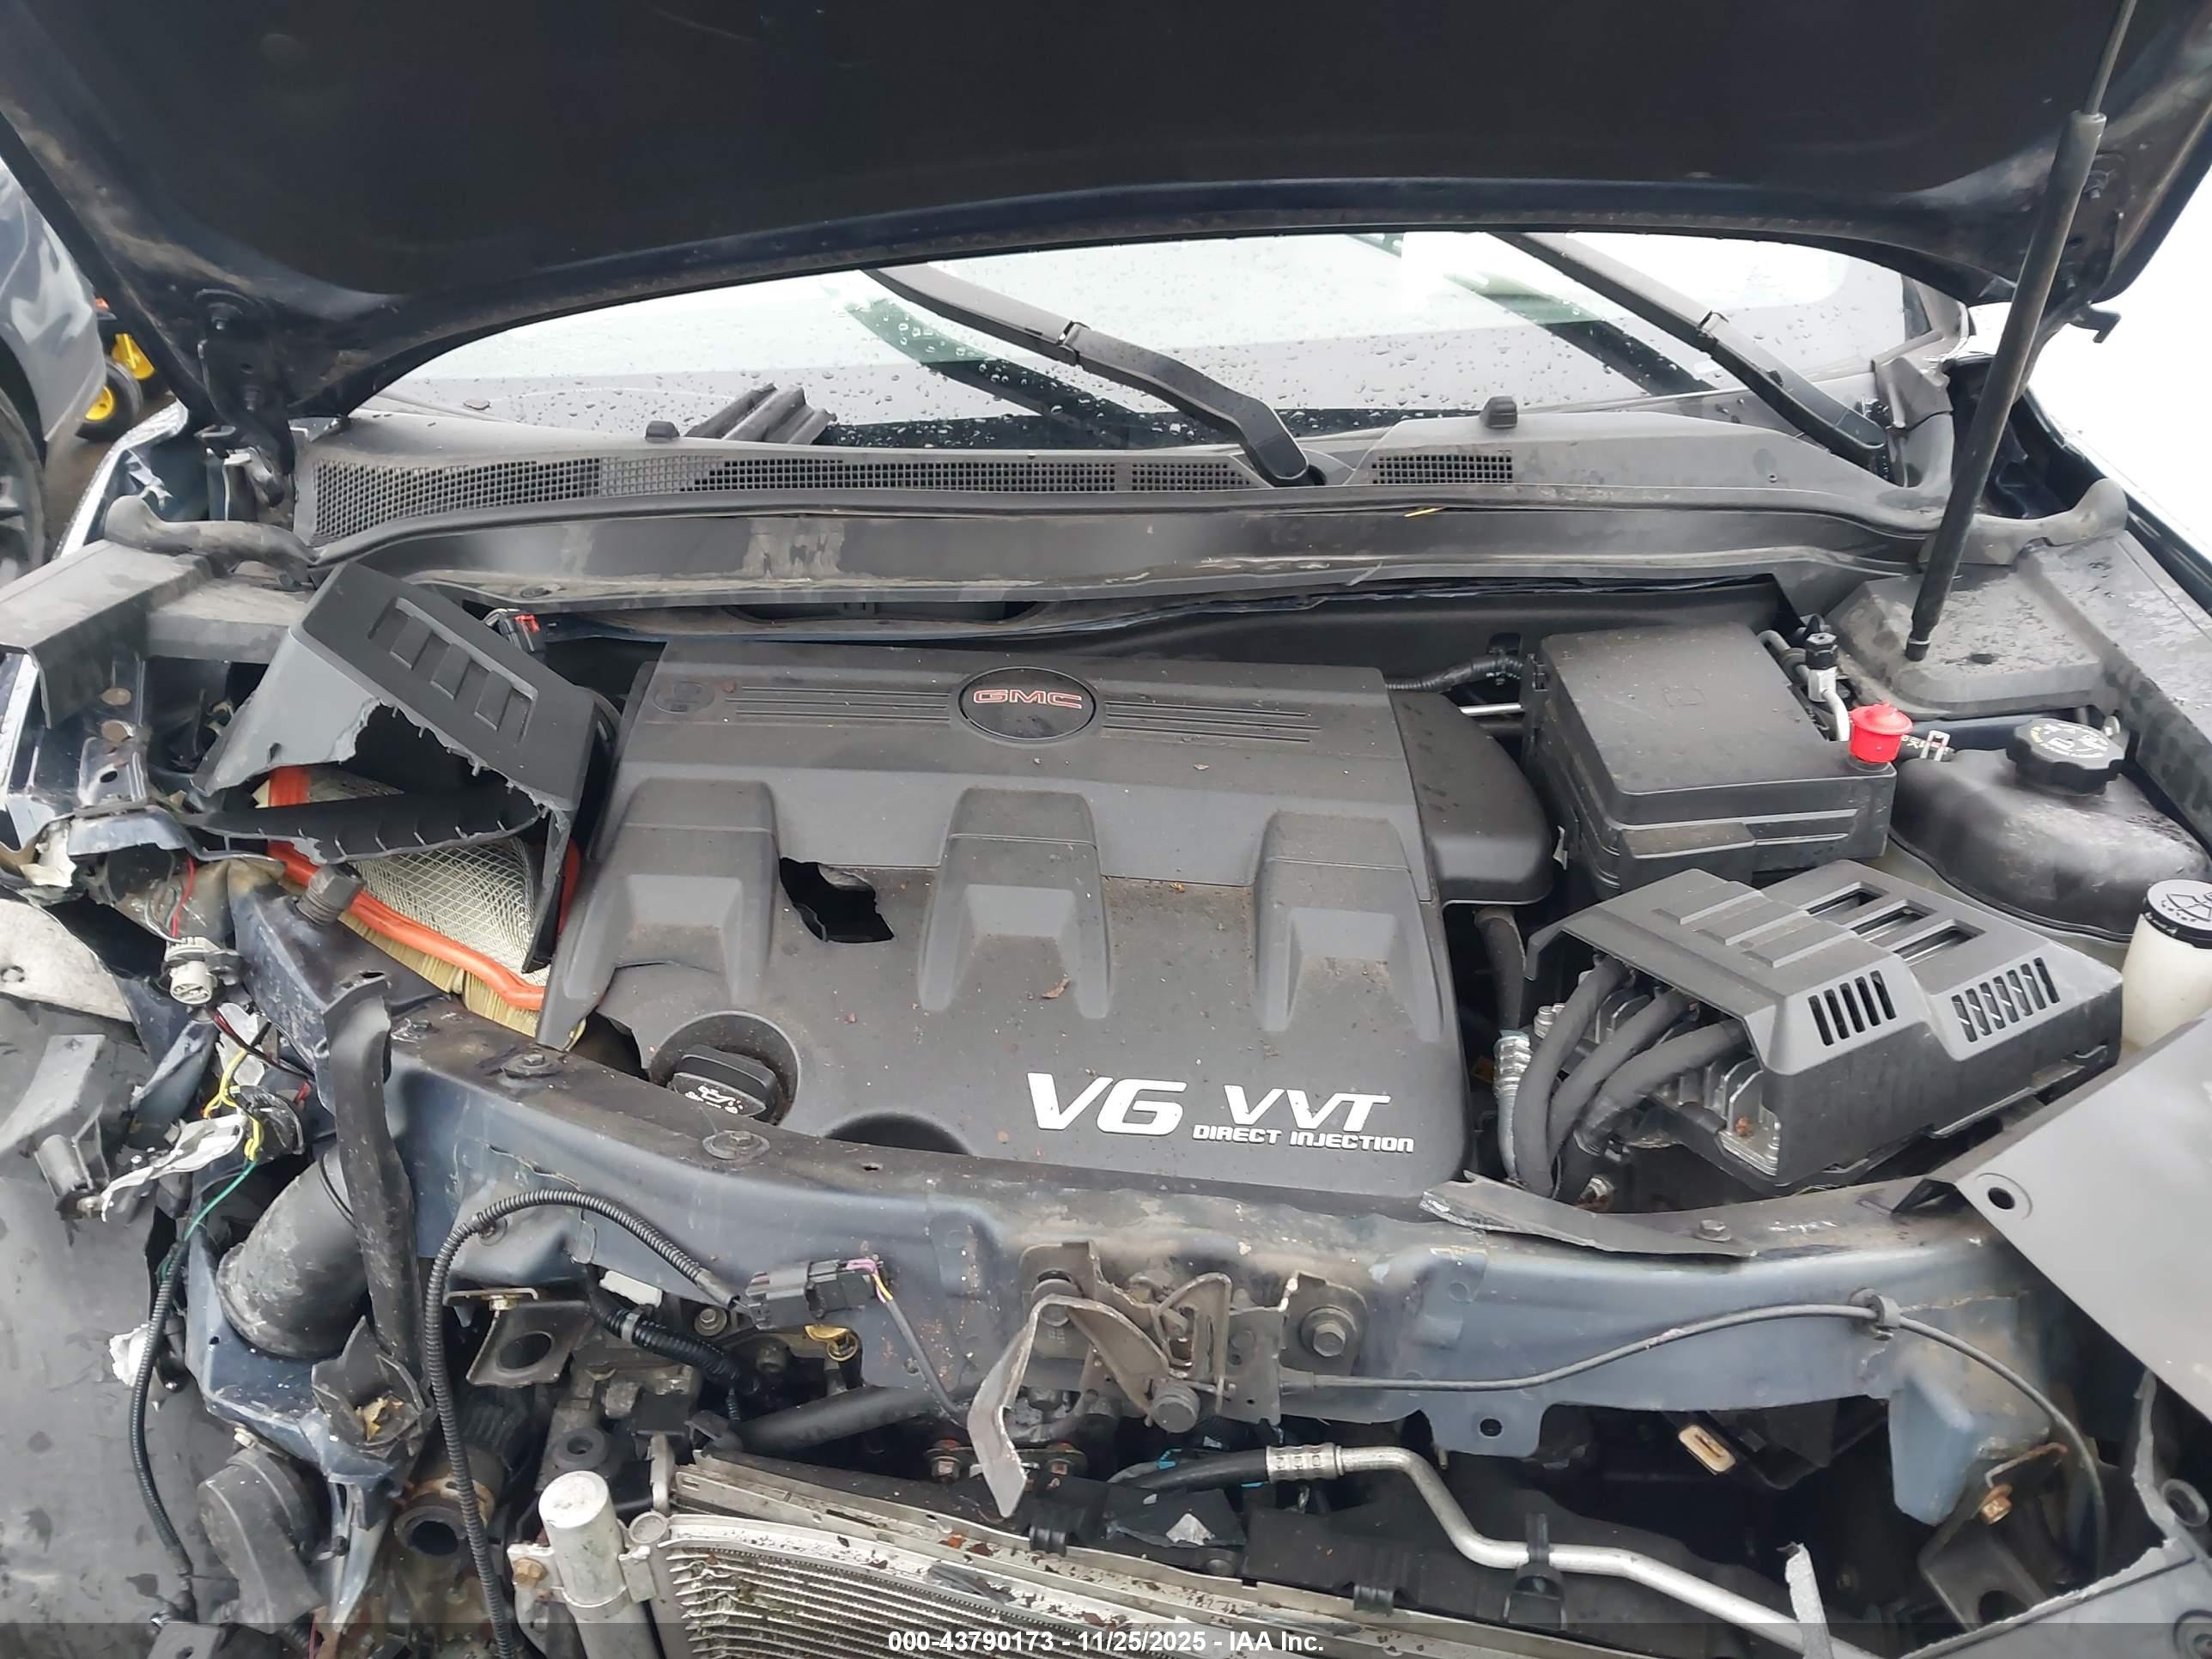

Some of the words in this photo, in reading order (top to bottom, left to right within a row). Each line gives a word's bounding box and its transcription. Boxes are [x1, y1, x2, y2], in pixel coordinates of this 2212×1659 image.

[973, 689, 1082, 709] GMC
[1026, 1072, 1188, 1136] V6
[1223, 1085, 1391, 1132] VVT
[1192, 1124, 1283, 1146] DIRECT
[1289, 1130, 1414, 1152] INJECTION
